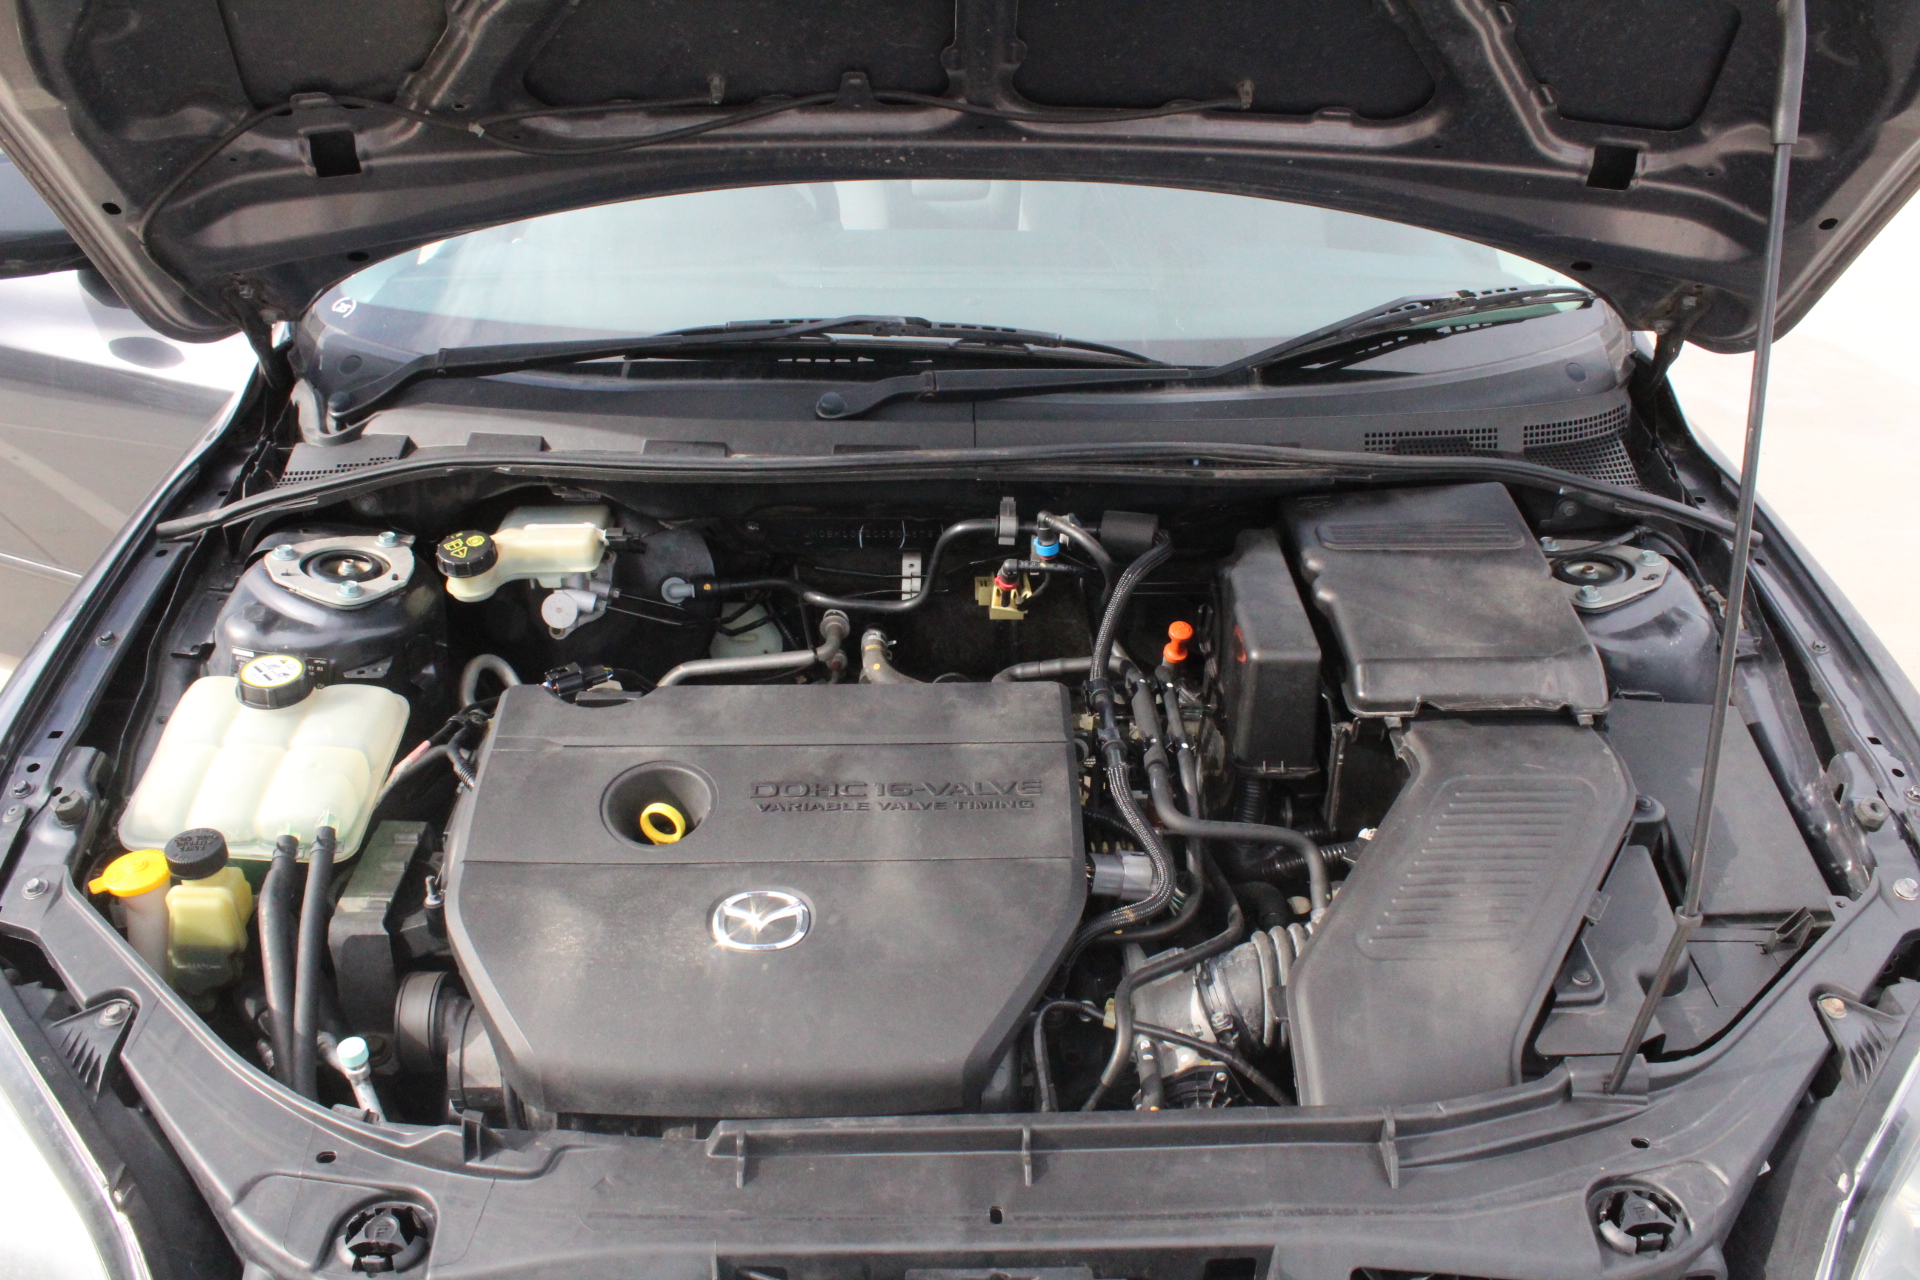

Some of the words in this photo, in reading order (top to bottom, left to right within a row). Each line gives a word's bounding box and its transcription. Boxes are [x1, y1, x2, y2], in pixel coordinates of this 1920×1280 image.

[750, 781, 868, 798] DOHC
[874, 780, 1042, 797] 16-VALVE
[756, 801, 870, 812] VARIABLE
[877, 801, 947, 811] VALVE
[953, 800, 1035, 810] TIMING
